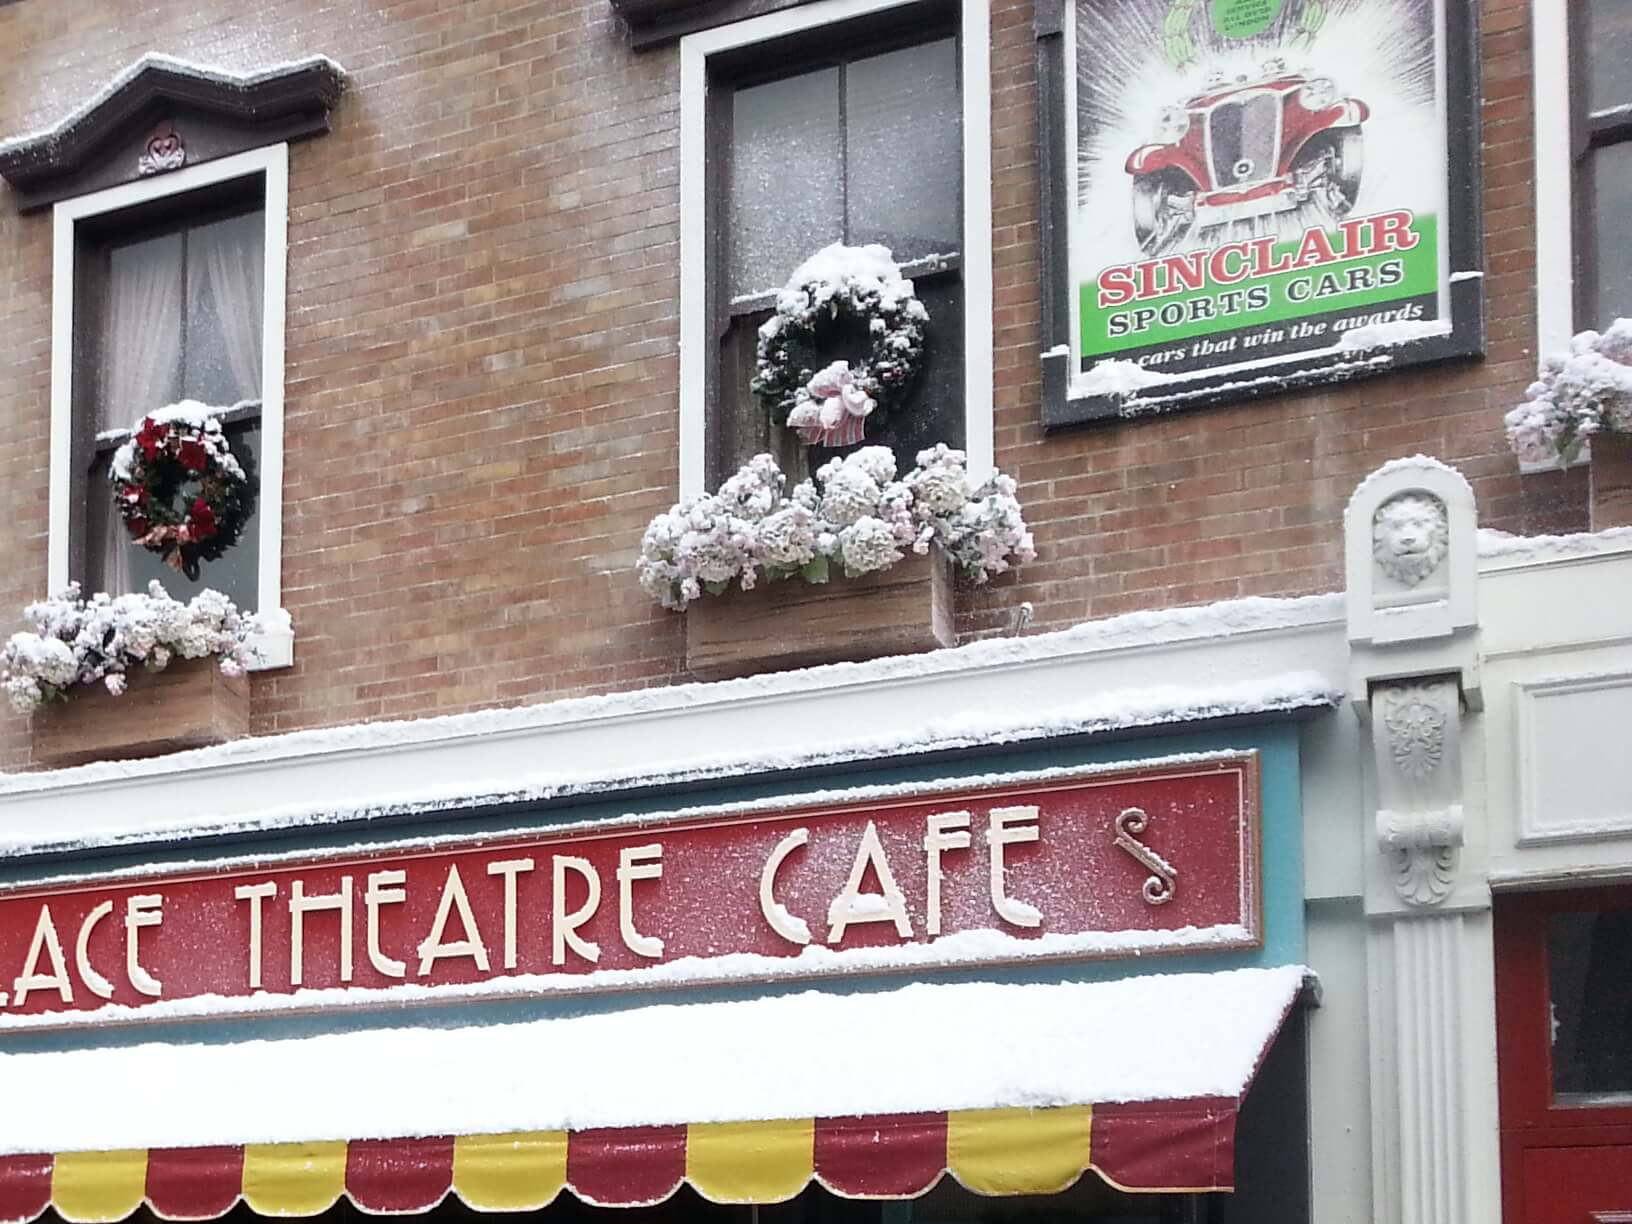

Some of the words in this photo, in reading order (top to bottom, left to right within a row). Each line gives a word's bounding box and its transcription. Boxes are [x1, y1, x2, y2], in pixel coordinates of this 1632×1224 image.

[1098, 208, 1420, 309] SINCLAIR
[1107, 286, 1268, 337] SPORTS
[1288, 260, 1403, 302] CARS
[1137, 348, 1187, 367] cars
[1192, 335, 1237, 357] that
[1243, 328, 1285, 350] win
[1291, 318, 1327, 340] the
[1332, 303, 1425, 332] awards
[234, 843, 664, 989] THEATRE
[759, 804, 1044, 945] CAFE
